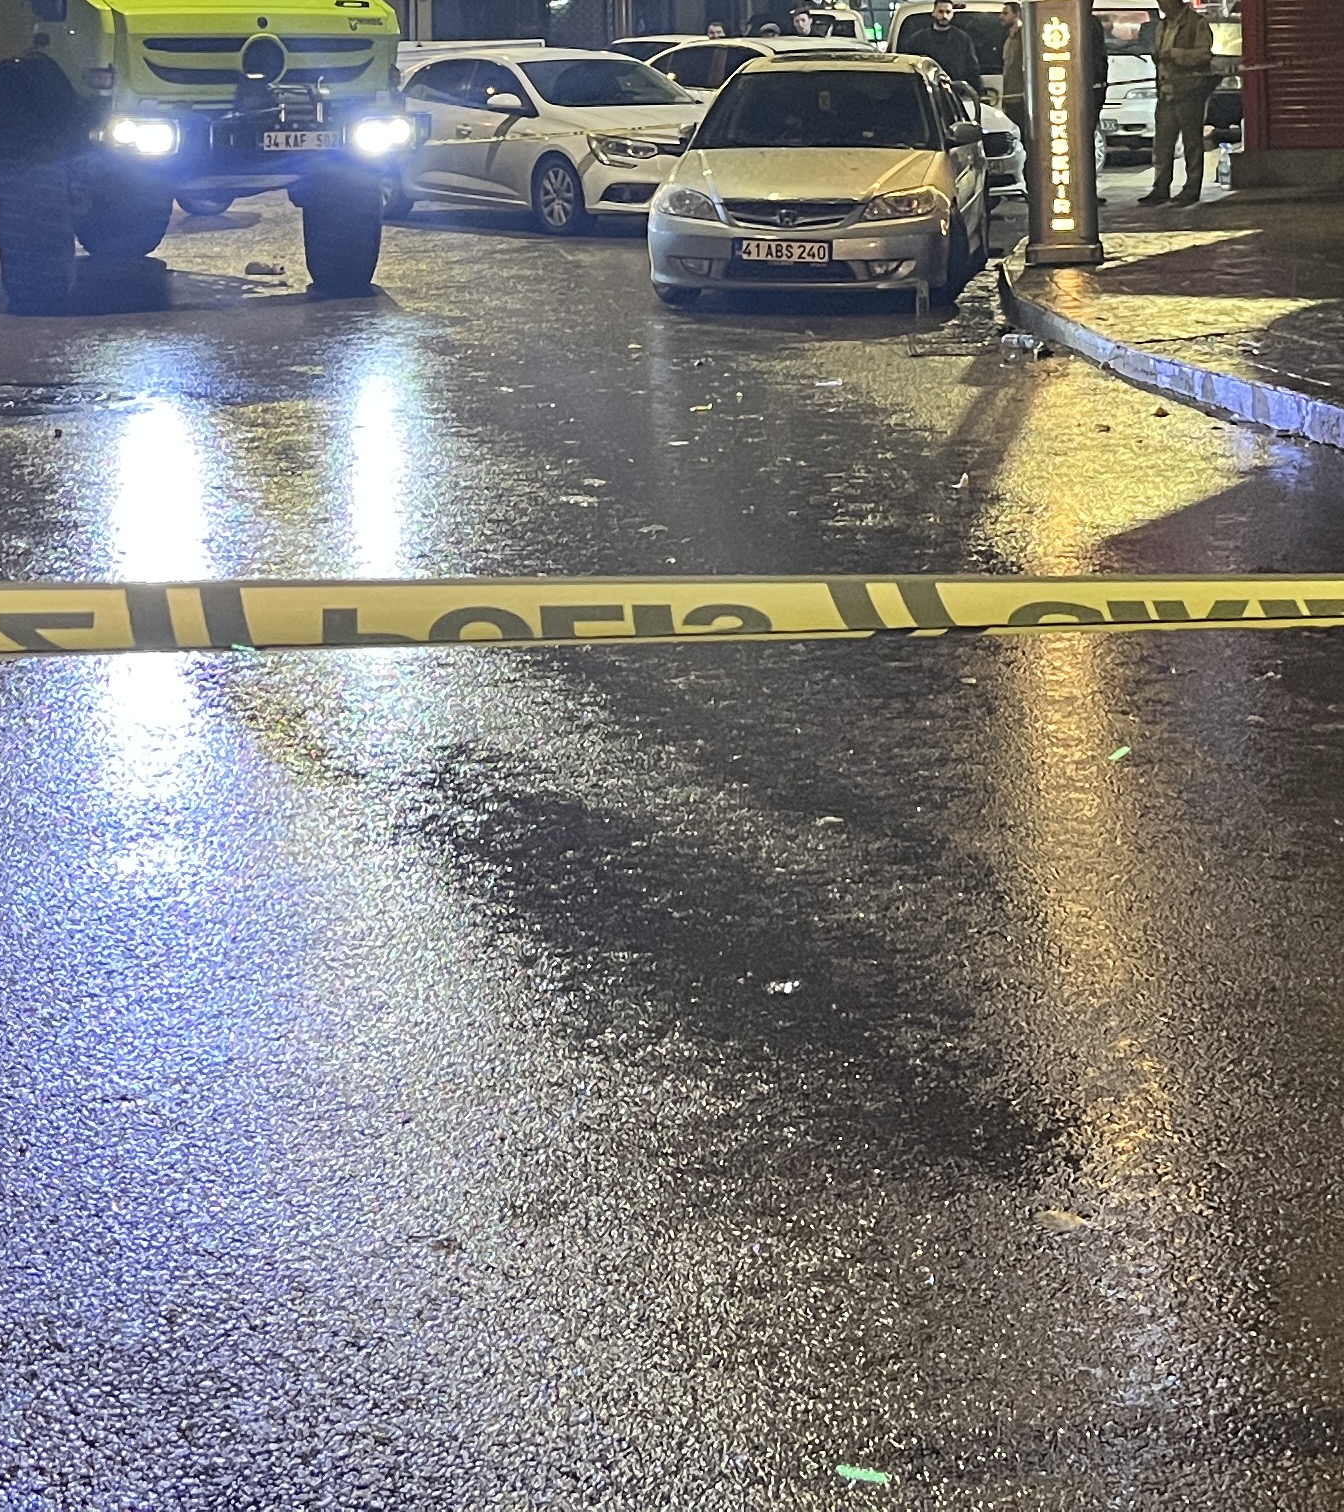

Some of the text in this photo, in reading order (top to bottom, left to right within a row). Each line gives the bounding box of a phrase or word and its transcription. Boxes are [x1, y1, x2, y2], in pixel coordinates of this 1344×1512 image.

[266, 134, 280, 148] 34
[285, 133, 307, 148] KAF
[742, 242, 826, 261] 41 ABS 240
